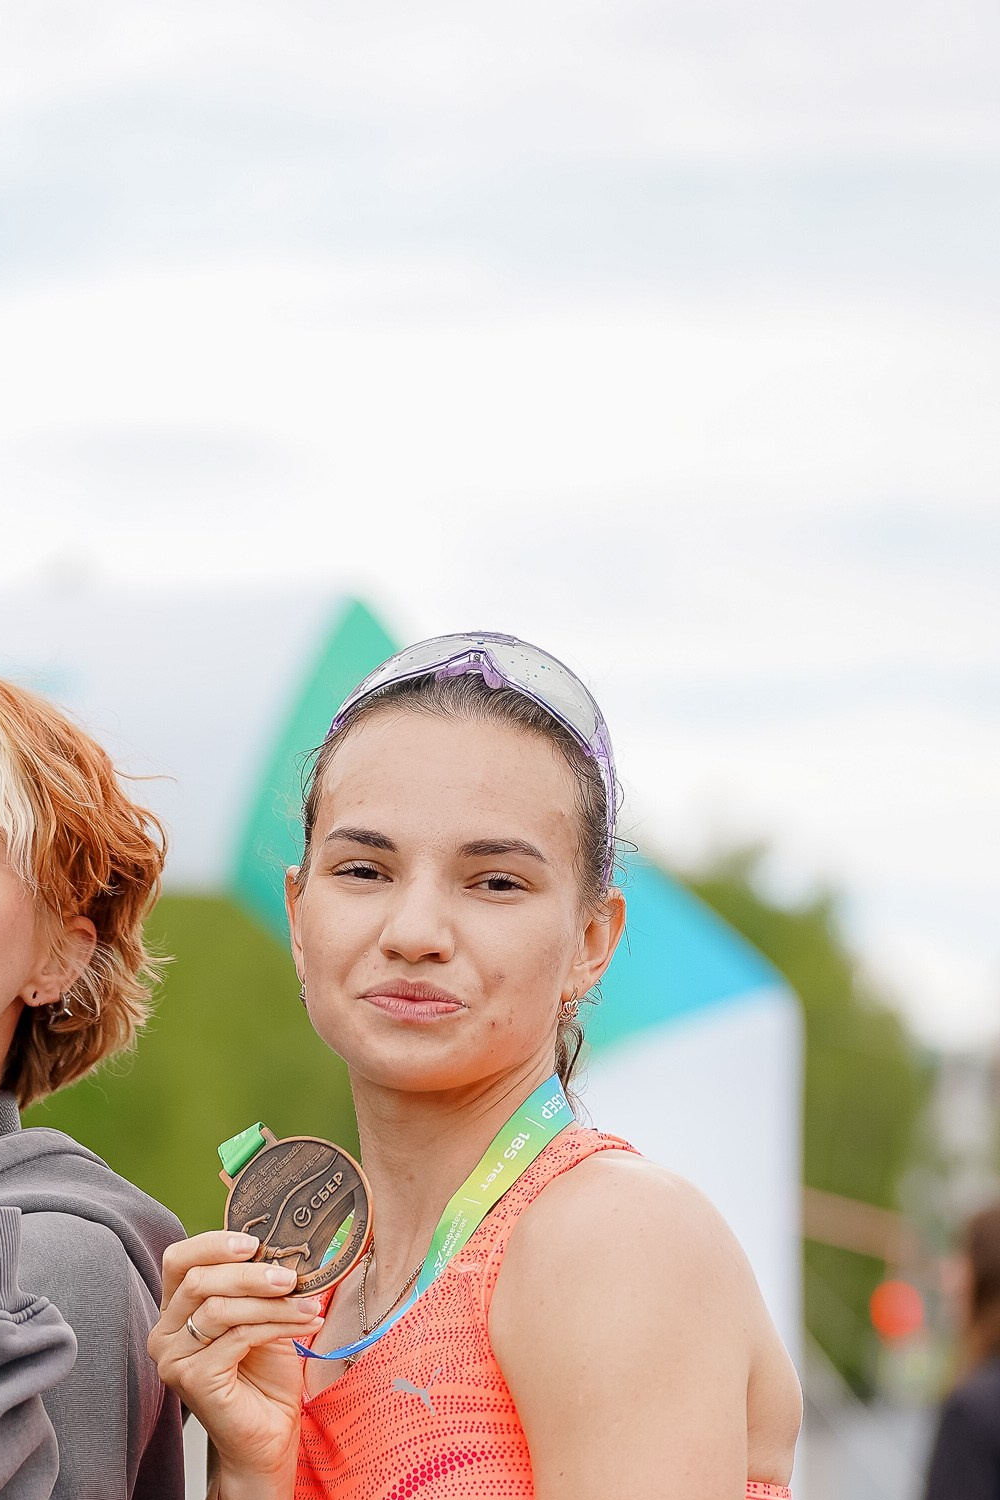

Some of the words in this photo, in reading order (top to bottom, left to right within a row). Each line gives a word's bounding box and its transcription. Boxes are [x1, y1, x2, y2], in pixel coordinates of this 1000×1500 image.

[541, 1093, 567, 1120] СБЕР
[503, 1131, 530, 1160] 185
[309, 1170, 344, 1209] СБЕР
[480, 1161, 505, 1192] лет
[442, 1210, 464, 1252] марафон
[299, 1262, 340, 1291] зелёный
[338, 1220, 367, 1266] марафон
